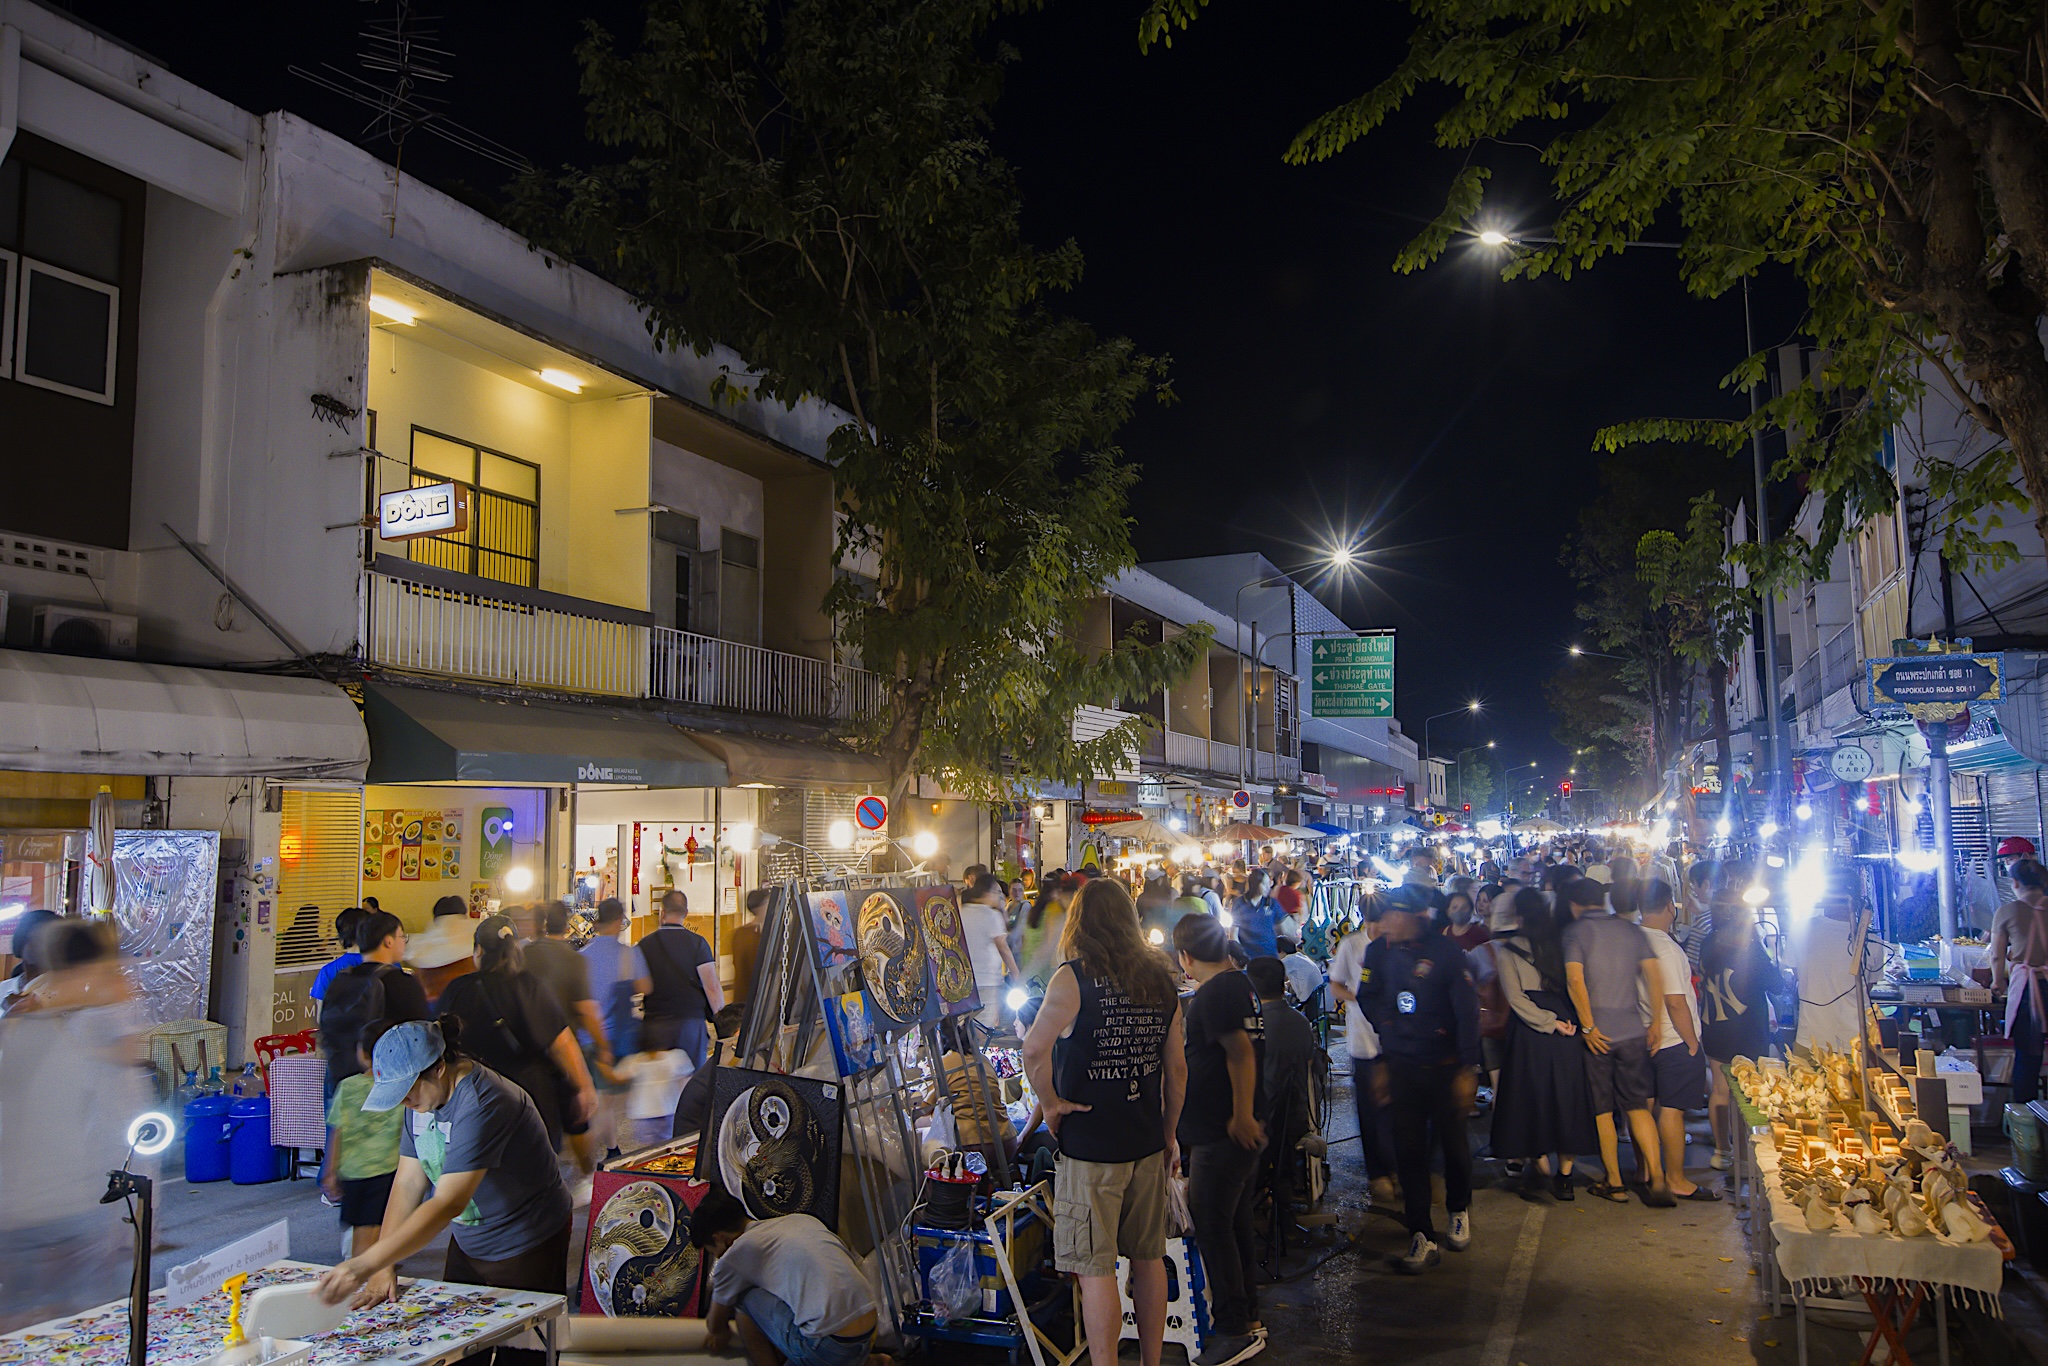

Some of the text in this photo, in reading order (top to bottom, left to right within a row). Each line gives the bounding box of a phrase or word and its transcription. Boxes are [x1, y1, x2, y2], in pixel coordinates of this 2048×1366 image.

[386, 494, 449, 523] DÔNG
[117, 638, 130, 646] LG
[1330, 638, 1390, 656] ประตูเชียงใหม่
[1895, 665, 1973, 681] ถนนพระปกเกล้า ซอย 11
[1894, 686, 1935, 694] PRAPOKKLAO
[1936, 685, 1954, 693] ROAD
[1956, 685, 1967, 693] SOI
[578, 762, 613, 780] DÔNG
[485, 860, 500, 871] City
[1099, 997, 1117, 1007] THE
[1105, 1017, 1124, 1026] BUT
[1093, 1028, 1110, 1038] PIN
[1112, 1026, 1131, 1036] THE
[1097, 1037, 1121, 1048] SKID
[1098, 1048, 1127, 1057] TOTALLY
[1091, 1058, 1127, 1068] SHOUTING
[1087, 1066, 1128, 1081] WHAT
[1130, 1065, 1140, 1077] A
